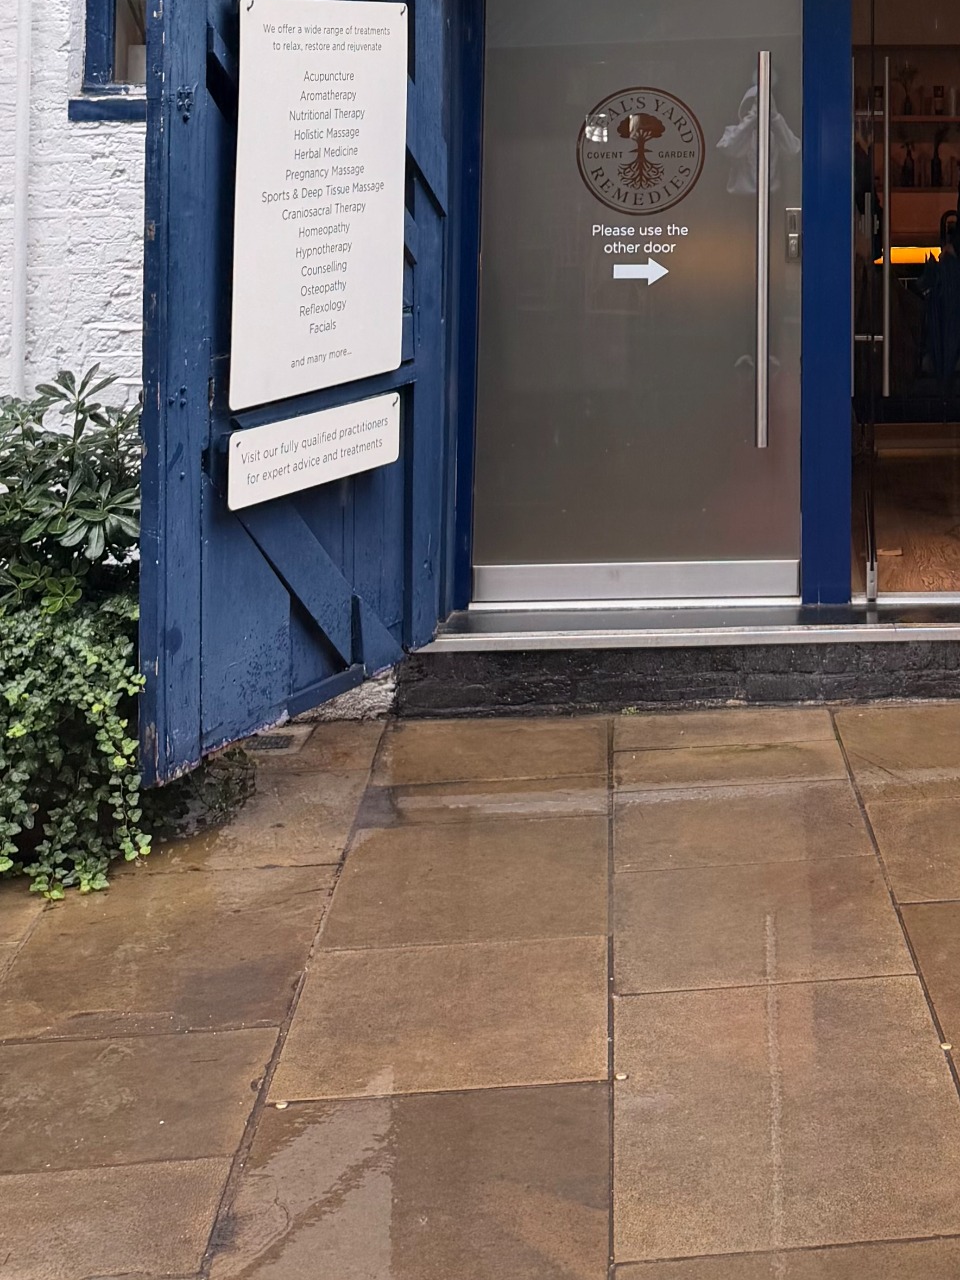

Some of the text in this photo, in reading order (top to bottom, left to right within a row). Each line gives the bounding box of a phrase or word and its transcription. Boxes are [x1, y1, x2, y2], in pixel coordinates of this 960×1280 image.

[263, 23, 391, 37] We offer a wide range of treatments
[272, 41, 382, 53] to relax, restore and rejuvenate
[303, 70, 355, 83] Acupuncture
[299, 89, 357, 102] Aromatherapy
[289, 108, 366, 121] Nutritional Therapy
[588, 96, 695, 145] EAL'S YARD
[294, 127, 360, 141] Holistic Massage
[294, 145, 359, 160] Herbal Medicine
[586, 150, 696, 160] COVENT GARDEN
[285, 164, 365, 181] Pregnancy Massage
[261, 180, 385, 204] Sports & Deep Tissue Massage
[590, 165, 692, 207] REMEDIES
[281, 201, 366, 221] Craniosacral Therapy
[298, 221, 350, 238] Homeopathy
[591, 224, 689, 237] Please use the
[295, 241, 353, 260] Hypnotherapy
[603, 241, 677, 254] other door
[301, 260, 348, 277] Counselling
[300, 279, 347, 297] Osteopathy
[299, 299, 347, 317] Reflexology
[309, 319, 337, 334] Facials
[290, 355, 306, 369] and
[306, 352, 327, 365] many
[241, 417, 389, 465] Visit our fully qualified practitioners
[247, 438, 383, 485] for expert advice and treatments
